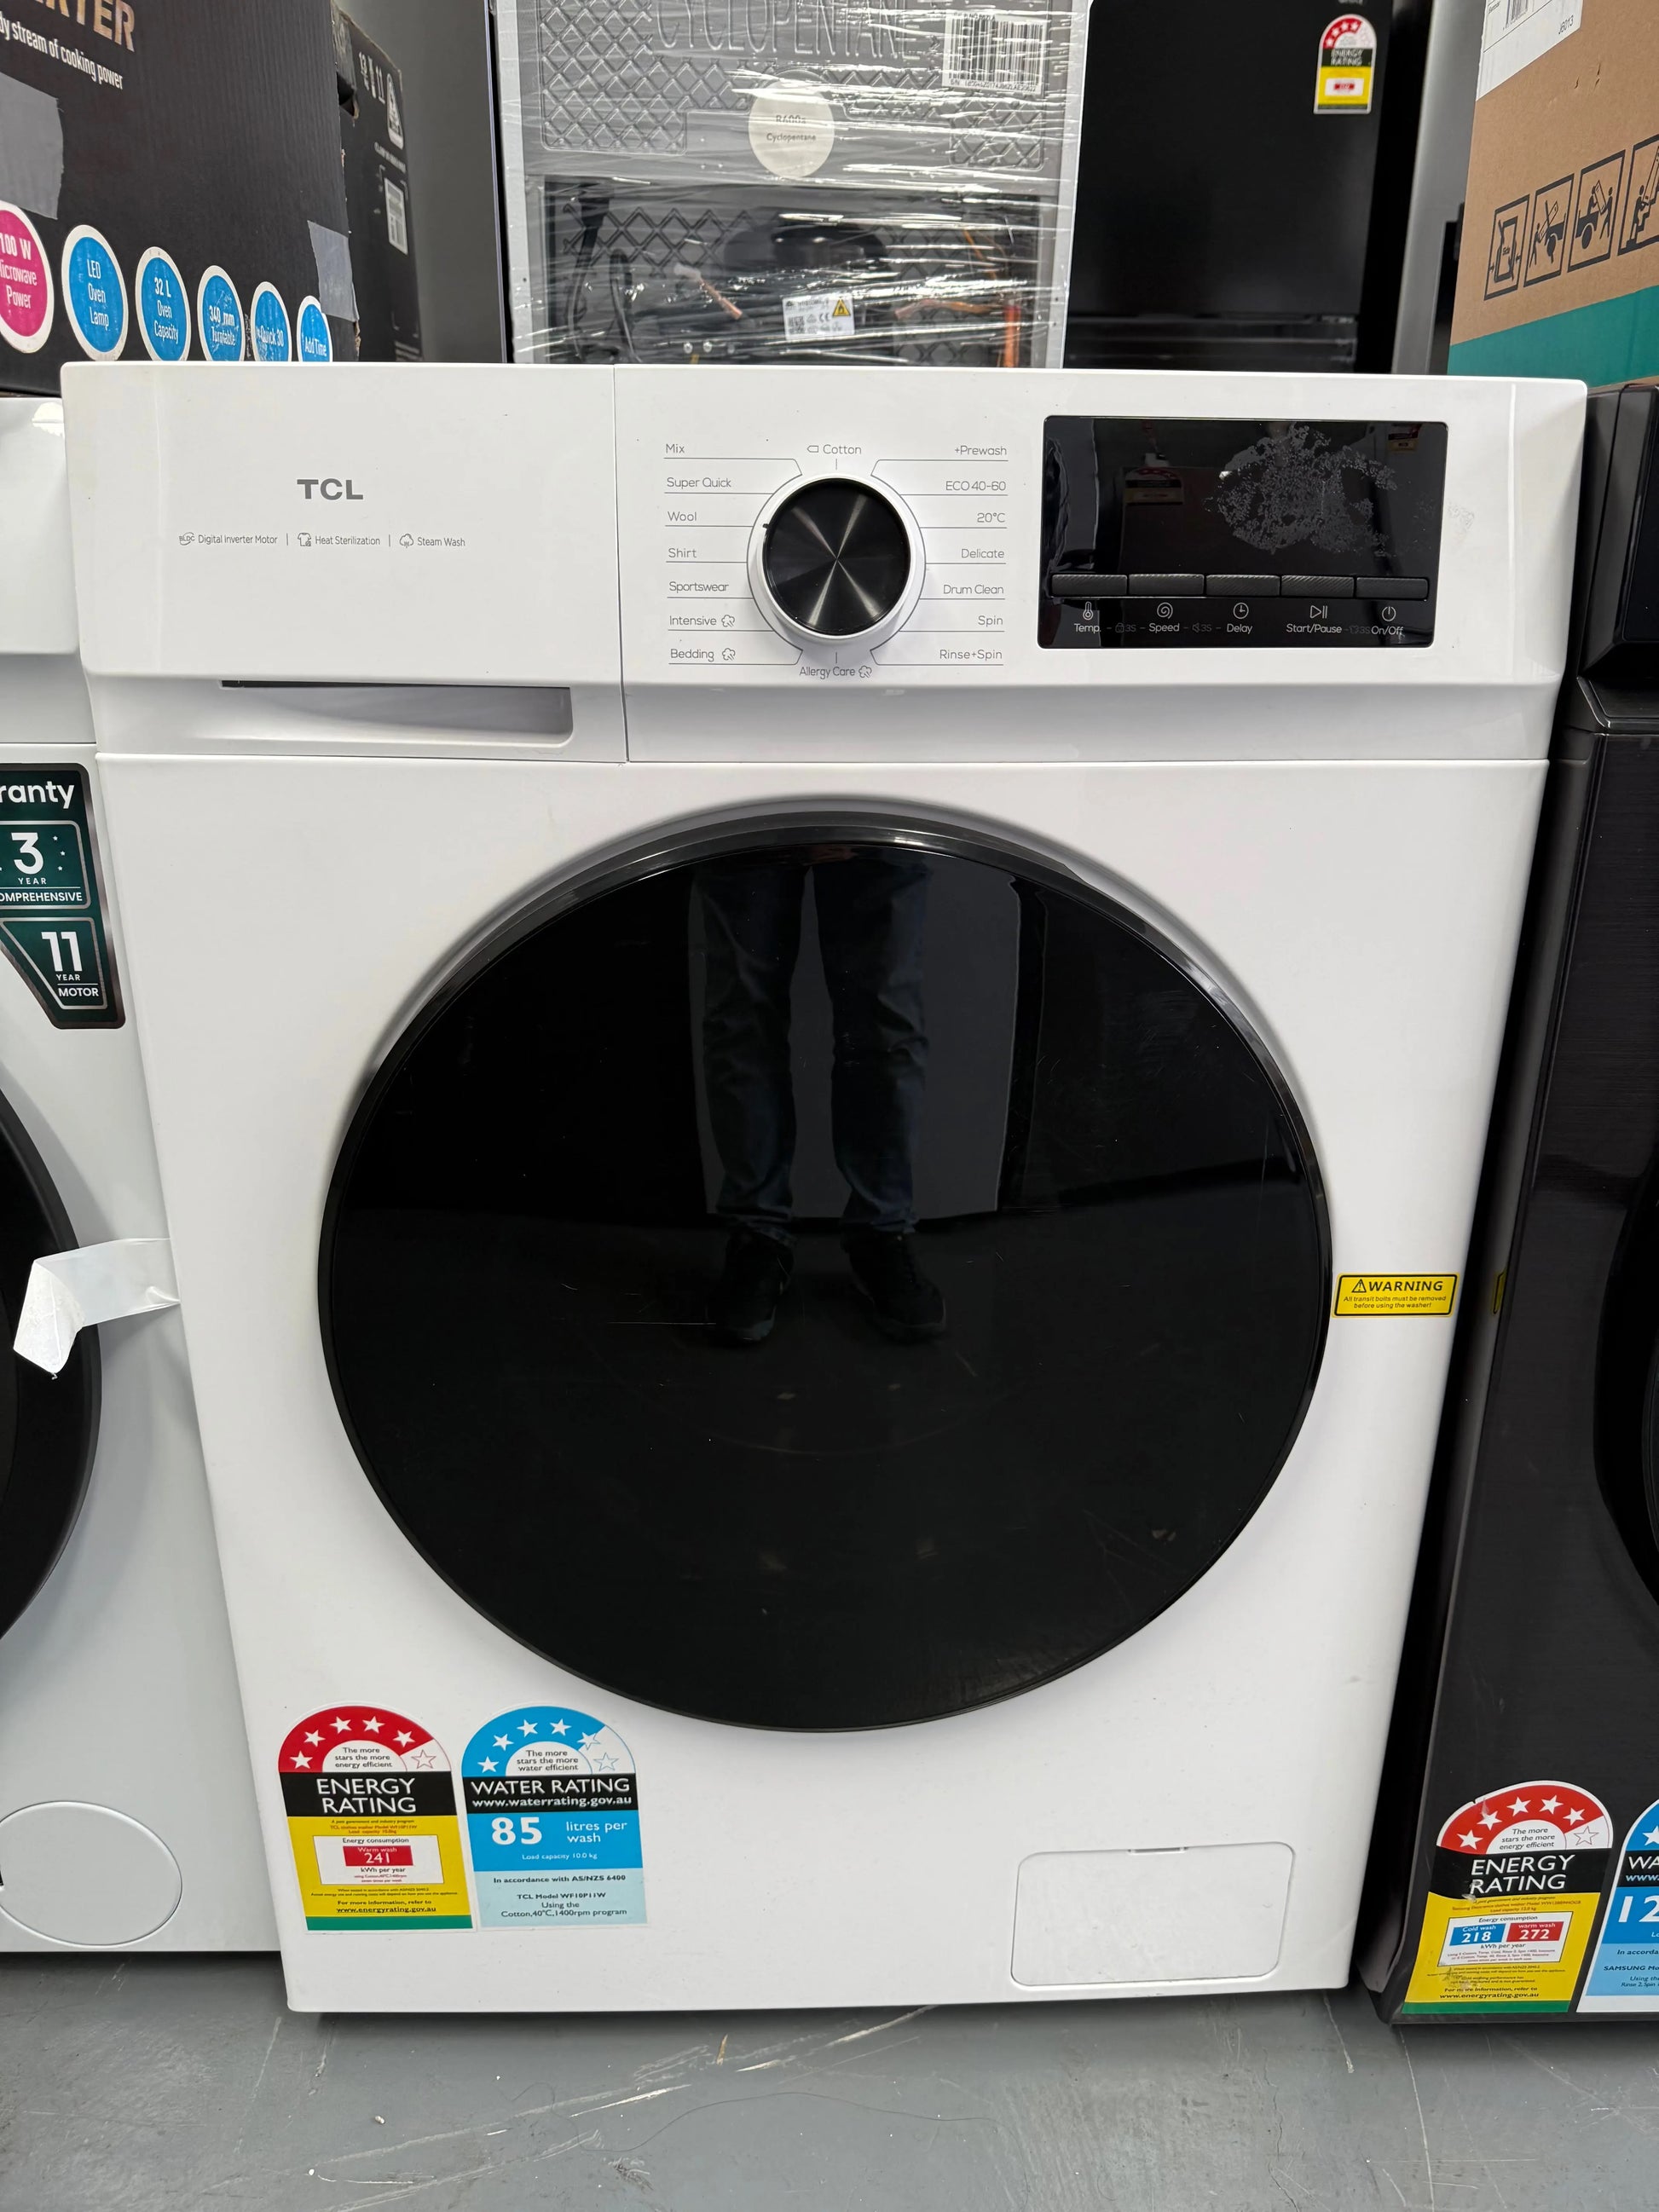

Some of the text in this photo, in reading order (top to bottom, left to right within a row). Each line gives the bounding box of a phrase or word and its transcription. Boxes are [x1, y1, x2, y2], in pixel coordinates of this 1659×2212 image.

[11, 20, 123, 90] stream of cooking power
[766, 132, 817, 144] Cyclopentane
[19, 238, 32, 260] W
[87, 258, 101, 280] LED
[88, 283, 106, 303] Oven
[154, 277, 171, 298] 32 L
[6, 285, 32, 309] Power
[157, 300, 172, 319] Oven
[209, 304, 235, 326] 340 mm
[90, 306, 109, 331] Lamp
[154, 320, 178, 344] Capacity
[211, 326, 236, 346] Turntable
[260, 325, 285, 348] Quick 30
[304, 337, 327, 357] Add Time
[666, 443, 685, 453] Mix
[823, 444, 862, 454] Cotton
[954, 445, 1007, 455] +Prewash
[297, 478, 364, 500] TCL
[667, 477, 731, 489] Super Quick
[945, 481, 1007, 491] ECO 40-60
[668, 511, 697, 522] Wool
[977, 512, 1006, 523] 20°C
[198, 534, 278, 545] Digital Inverter Motor
[315, 535, 380, 546] Heat Sterilization
[417, 536, 465, 547] Steam Wash
[668, 548, 697, 558] Shirt
[961, 548, 1005, 558] Delicate
[669, 581, 730, 593] Sportswear
[943, 584, 1004, 594] Drum Clean
[669, 615, 717, 626] Intensive
[978, 615, 1003, 627] Spin
[1074, 623, 1101, 633] Temp.
[1148, 623, 1180, 633] Speed
[1227, 623, 1253, 634] Delay
[1286, 623, 1343, 633] Start/Pause
[1371, 625, 1404, 635] On/Off
[671, 649, 714, 661] Bedding
[939, 649, 1003, 661] Rinse+Spin
[800, 667, 856, 679] Allergy Care
[11, 832, 43, 875] 3
[41, 932, 83, 972] 11
[58, 988, 99, 997] MOTOR
[1369, 1281, 1443, 1291] WARNING
[316, 1778, 415, 1794] ENERGY
[471, 1778, 630, 1795] WATER RATING
[322, 1797, 416, 1814] RATING
[471, 1796, 632, 1808] www.waterrating.gov.au
[491, 1816, 542, 1845] 85
[566, 1822, 627, 1833] litres per
[567, 1834, 601, 1843] wash
[364, 1852, 390, 1863] 241
[1471, 1854, 1575, 1875] ENERGY
[1470, 1874, 1567, 1895] RATING
[1618, 1895, 1659, 1923] 12
[1461, 1932, 1492, 1943] 218
[1519, 1929, 1550, 1940] 272
